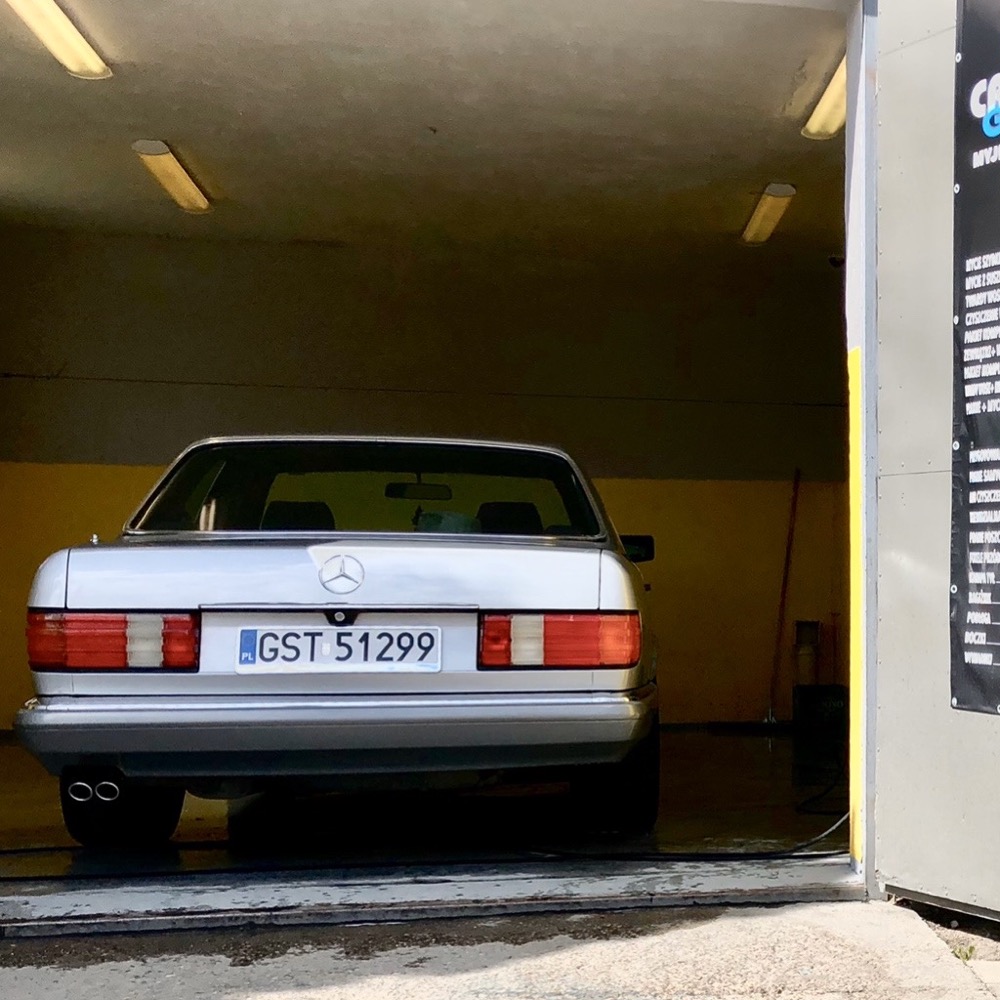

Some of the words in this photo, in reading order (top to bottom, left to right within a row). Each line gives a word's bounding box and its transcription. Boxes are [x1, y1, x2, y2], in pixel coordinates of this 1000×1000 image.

[241, 652, 254, 661] PL
[258, 632, 323, 662] GST
[335, 632, 435, 662] 51299
